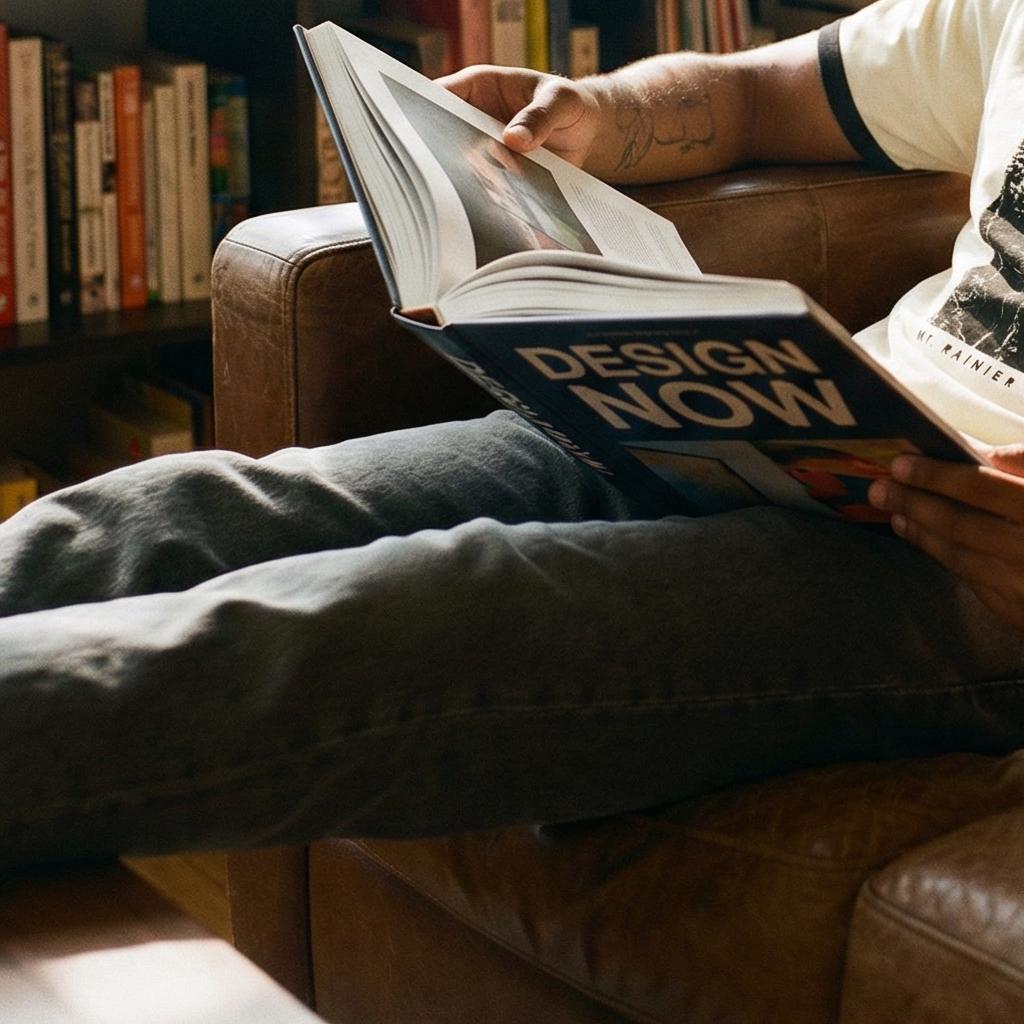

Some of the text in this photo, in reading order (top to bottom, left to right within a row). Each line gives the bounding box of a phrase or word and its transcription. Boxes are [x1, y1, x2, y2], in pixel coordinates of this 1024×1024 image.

[514, 339, 823, 381] DESIGN
[940, 343, 1017, 388] RAINIER
[567, 378, 858, 430] NOW
